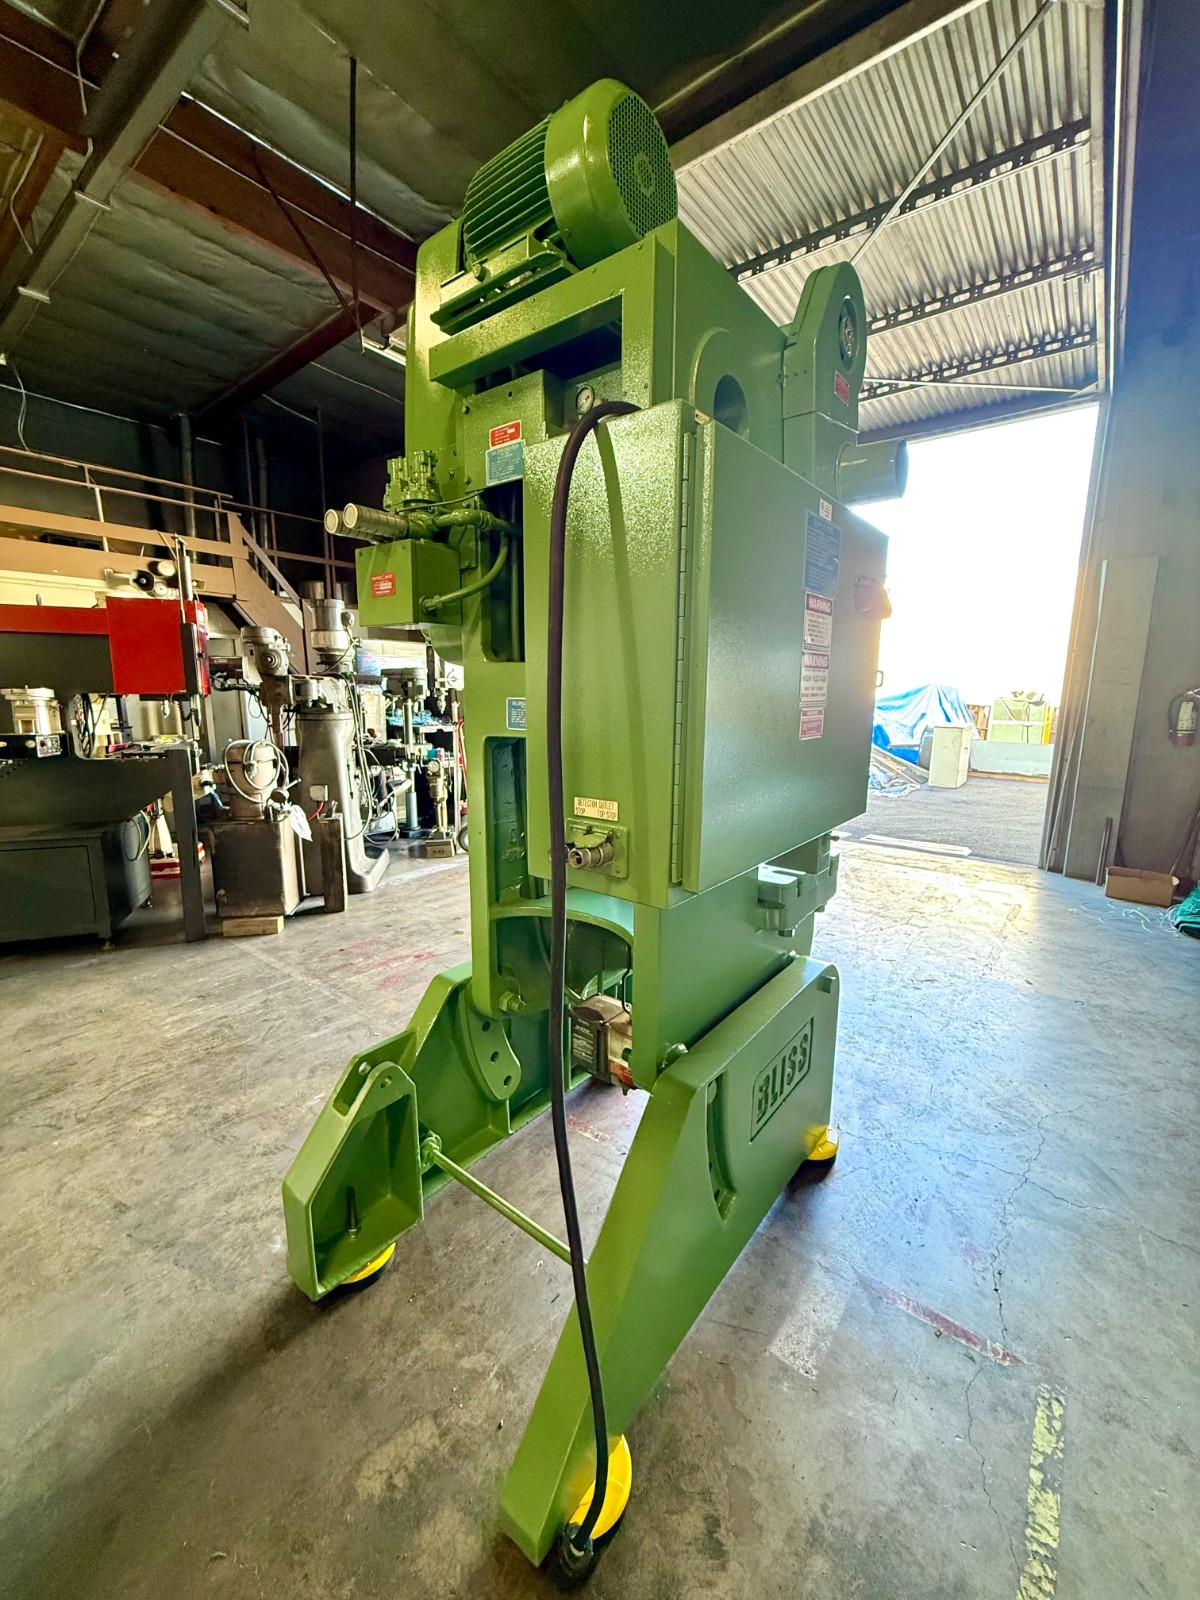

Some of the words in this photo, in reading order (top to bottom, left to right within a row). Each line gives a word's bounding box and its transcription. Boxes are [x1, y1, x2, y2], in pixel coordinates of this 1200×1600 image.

[809, 597, 831, 613] WARNING
[804, 653, 828, 668] WARNING
[577, 799, 598, 809] DETECTOR
[598, 801, 614, 811] OUTLET
[606, 811, 617, 820] STOP
[756, 1032, 809, 1125] BLISS
